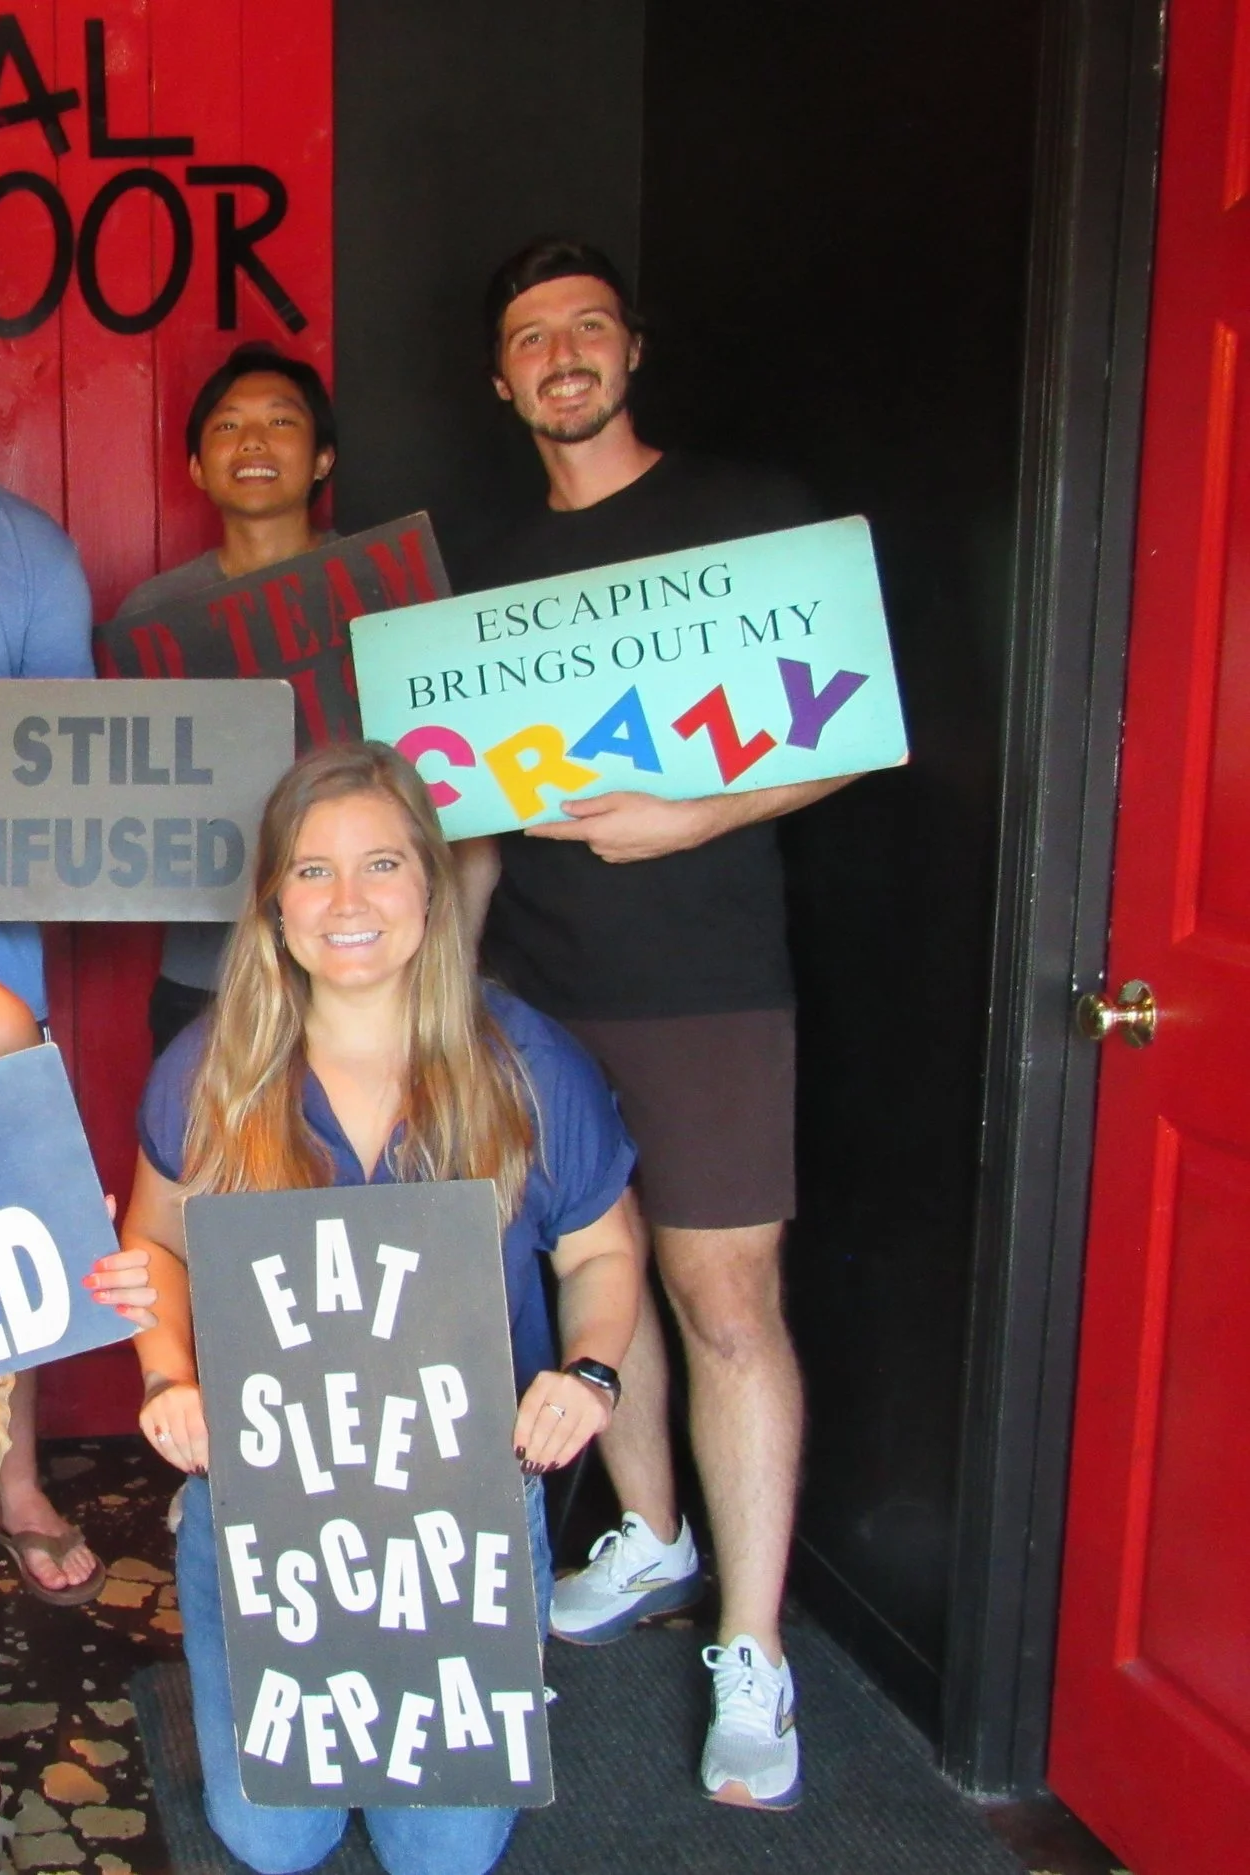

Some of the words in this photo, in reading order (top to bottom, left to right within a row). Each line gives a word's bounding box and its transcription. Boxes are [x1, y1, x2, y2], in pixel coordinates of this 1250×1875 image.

[208, 529, 438, 681] TEAM
[406, 643, 596, 709] BRINGS
[611, 620, 717, 669] OUT
[741, 600, 822, 648] MY
[474, 562, 733, 644] ESCAPING
[12, 716, 213, 786] STILL
[394, 657, 870, 821] CRAZY
[251, 1218, 419, 1350] EAT
[239, 1363, 469, 1494] SLEEP
[225, 1510, 509, 1643] ESCAPE
[244, 1656, 533, 1786] REPEAT
